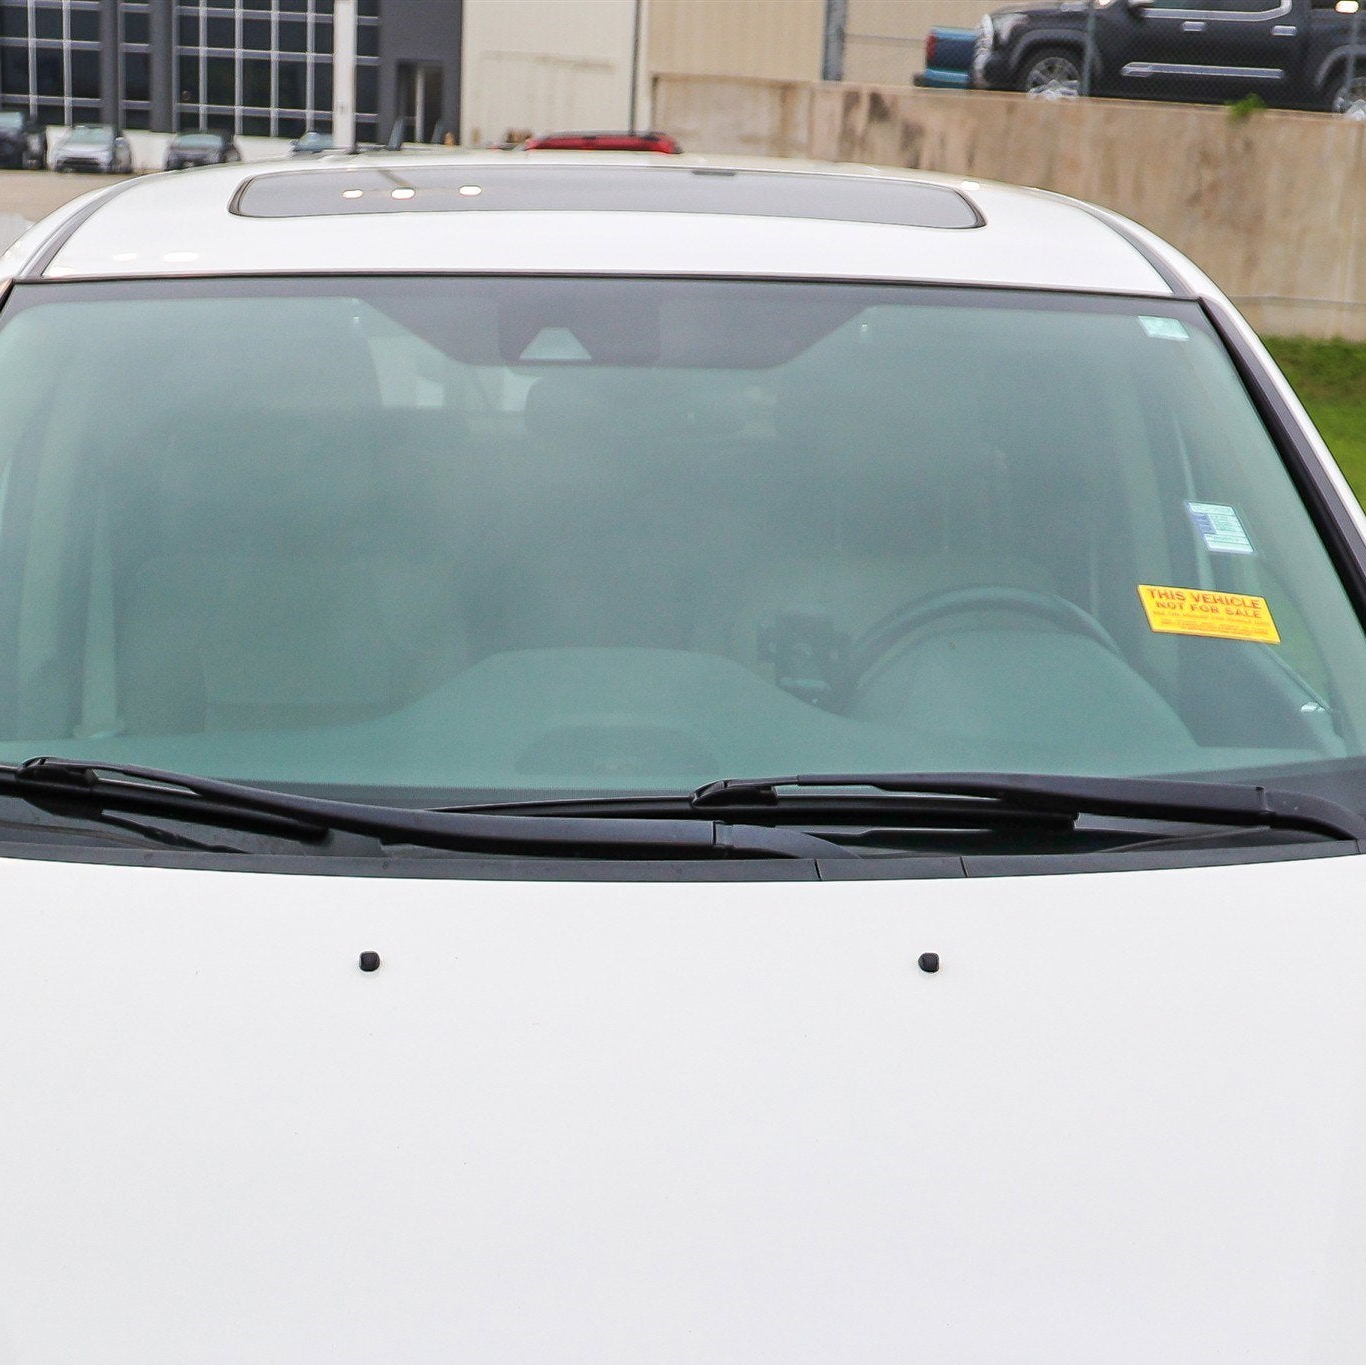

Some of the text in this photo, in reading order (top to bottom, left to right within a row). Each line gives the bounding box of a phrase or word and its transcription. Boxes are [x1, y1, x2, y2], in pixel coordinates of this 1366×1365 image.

[1147, 588, 1262, 609] THIS VEHICLE
[1155, 601, 1262, 619] NOT FOR SALE
